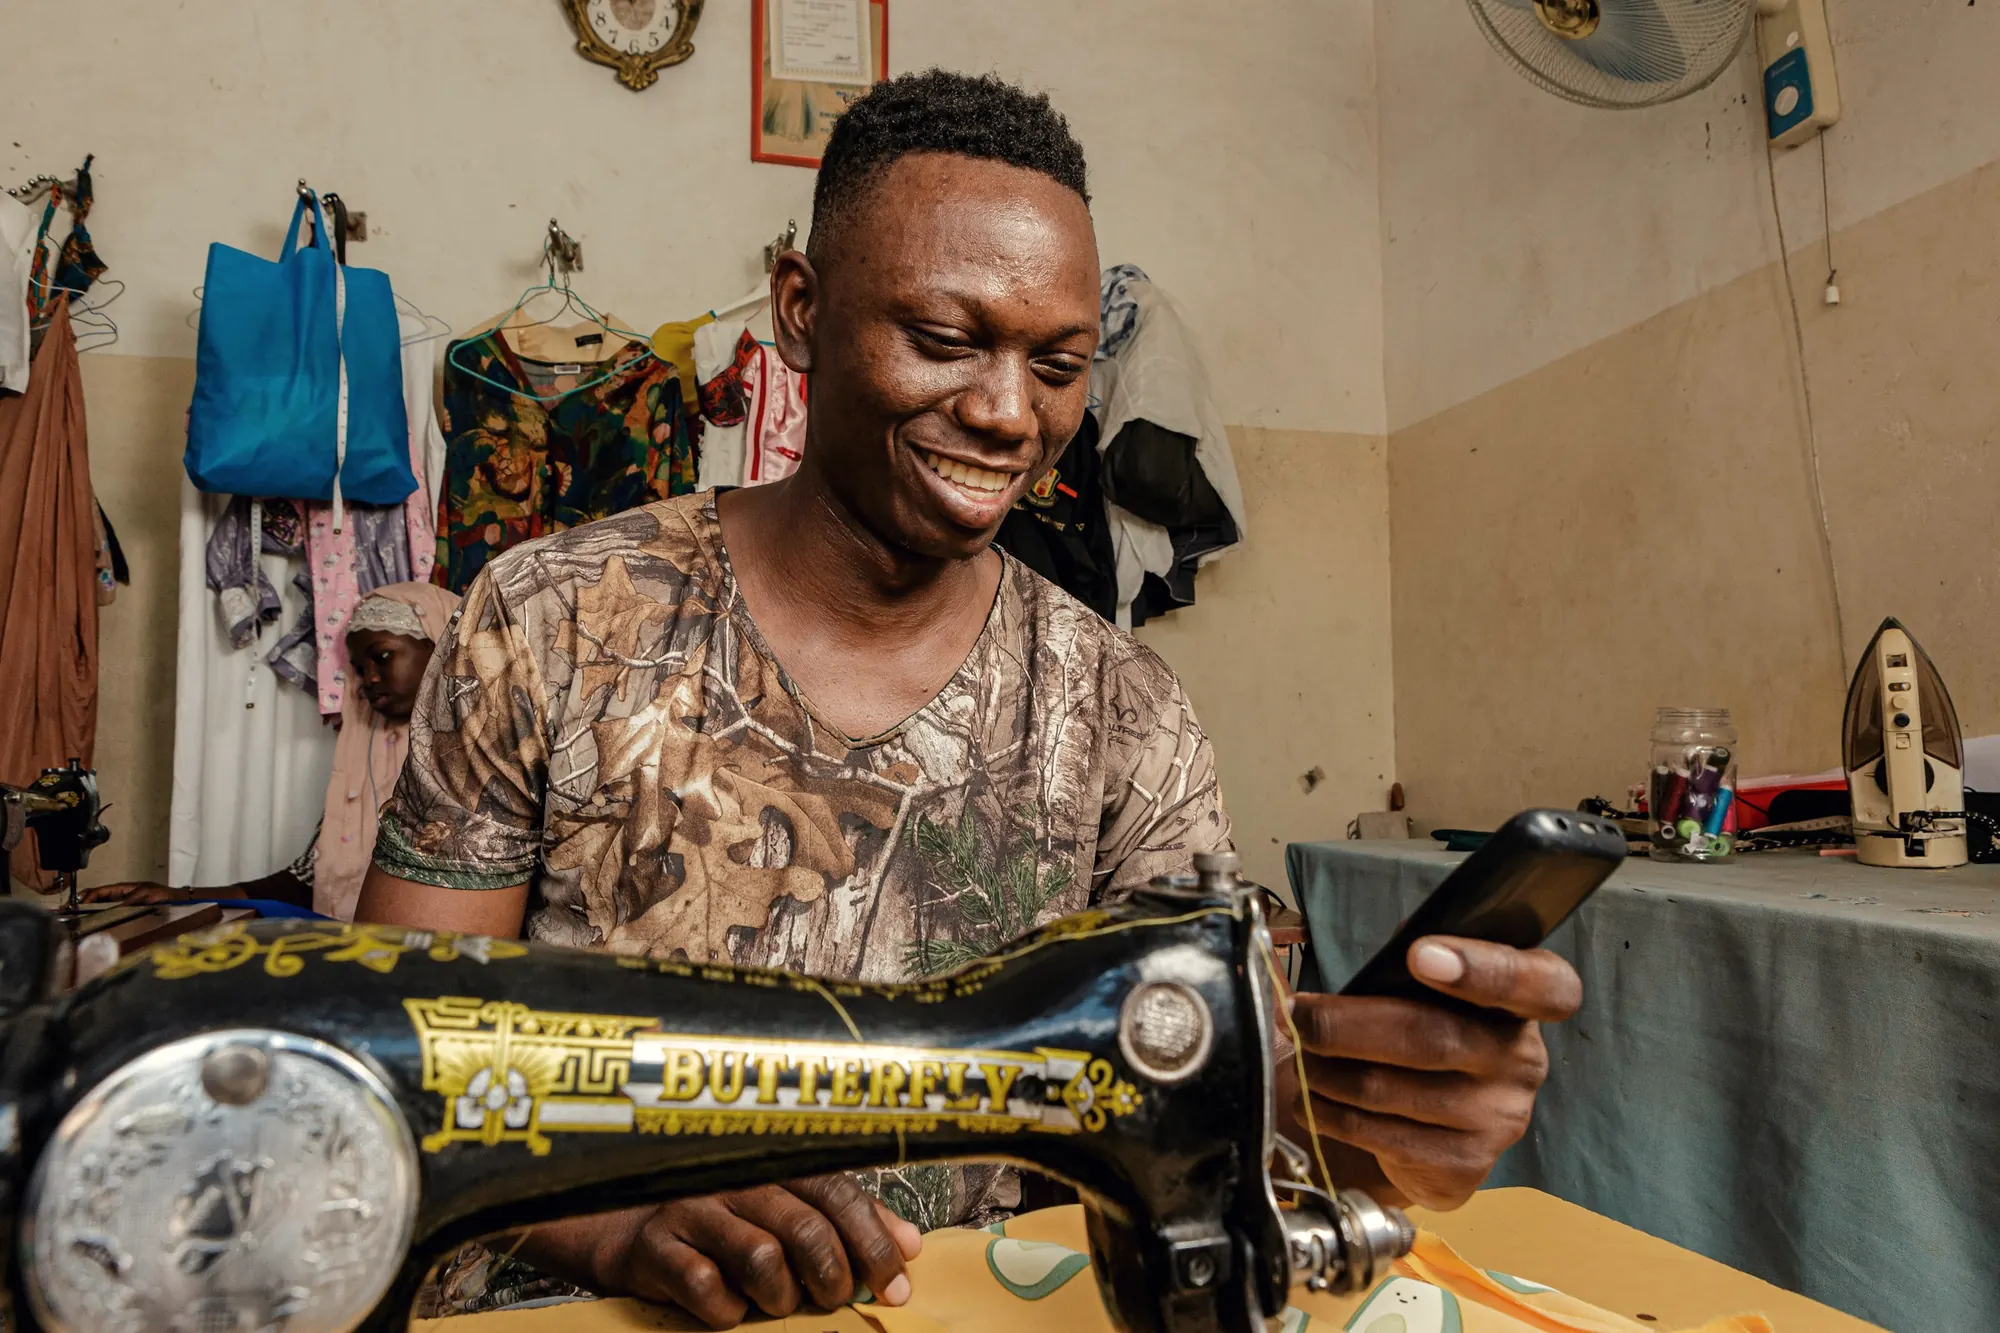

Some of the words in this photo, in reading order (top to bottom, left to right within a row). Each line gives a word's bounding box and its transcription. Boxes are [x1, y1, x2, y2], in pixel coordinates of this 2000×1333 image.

[595, 11, 606, 28] 8
[659, 15, 672, 30] 4
[608, 29, 618, 44] 7
[648, 32, 659, 47] 5
[629, 38, 640, 53] 6
[657, 1047, 1023, 1115] BUTTERFLY
